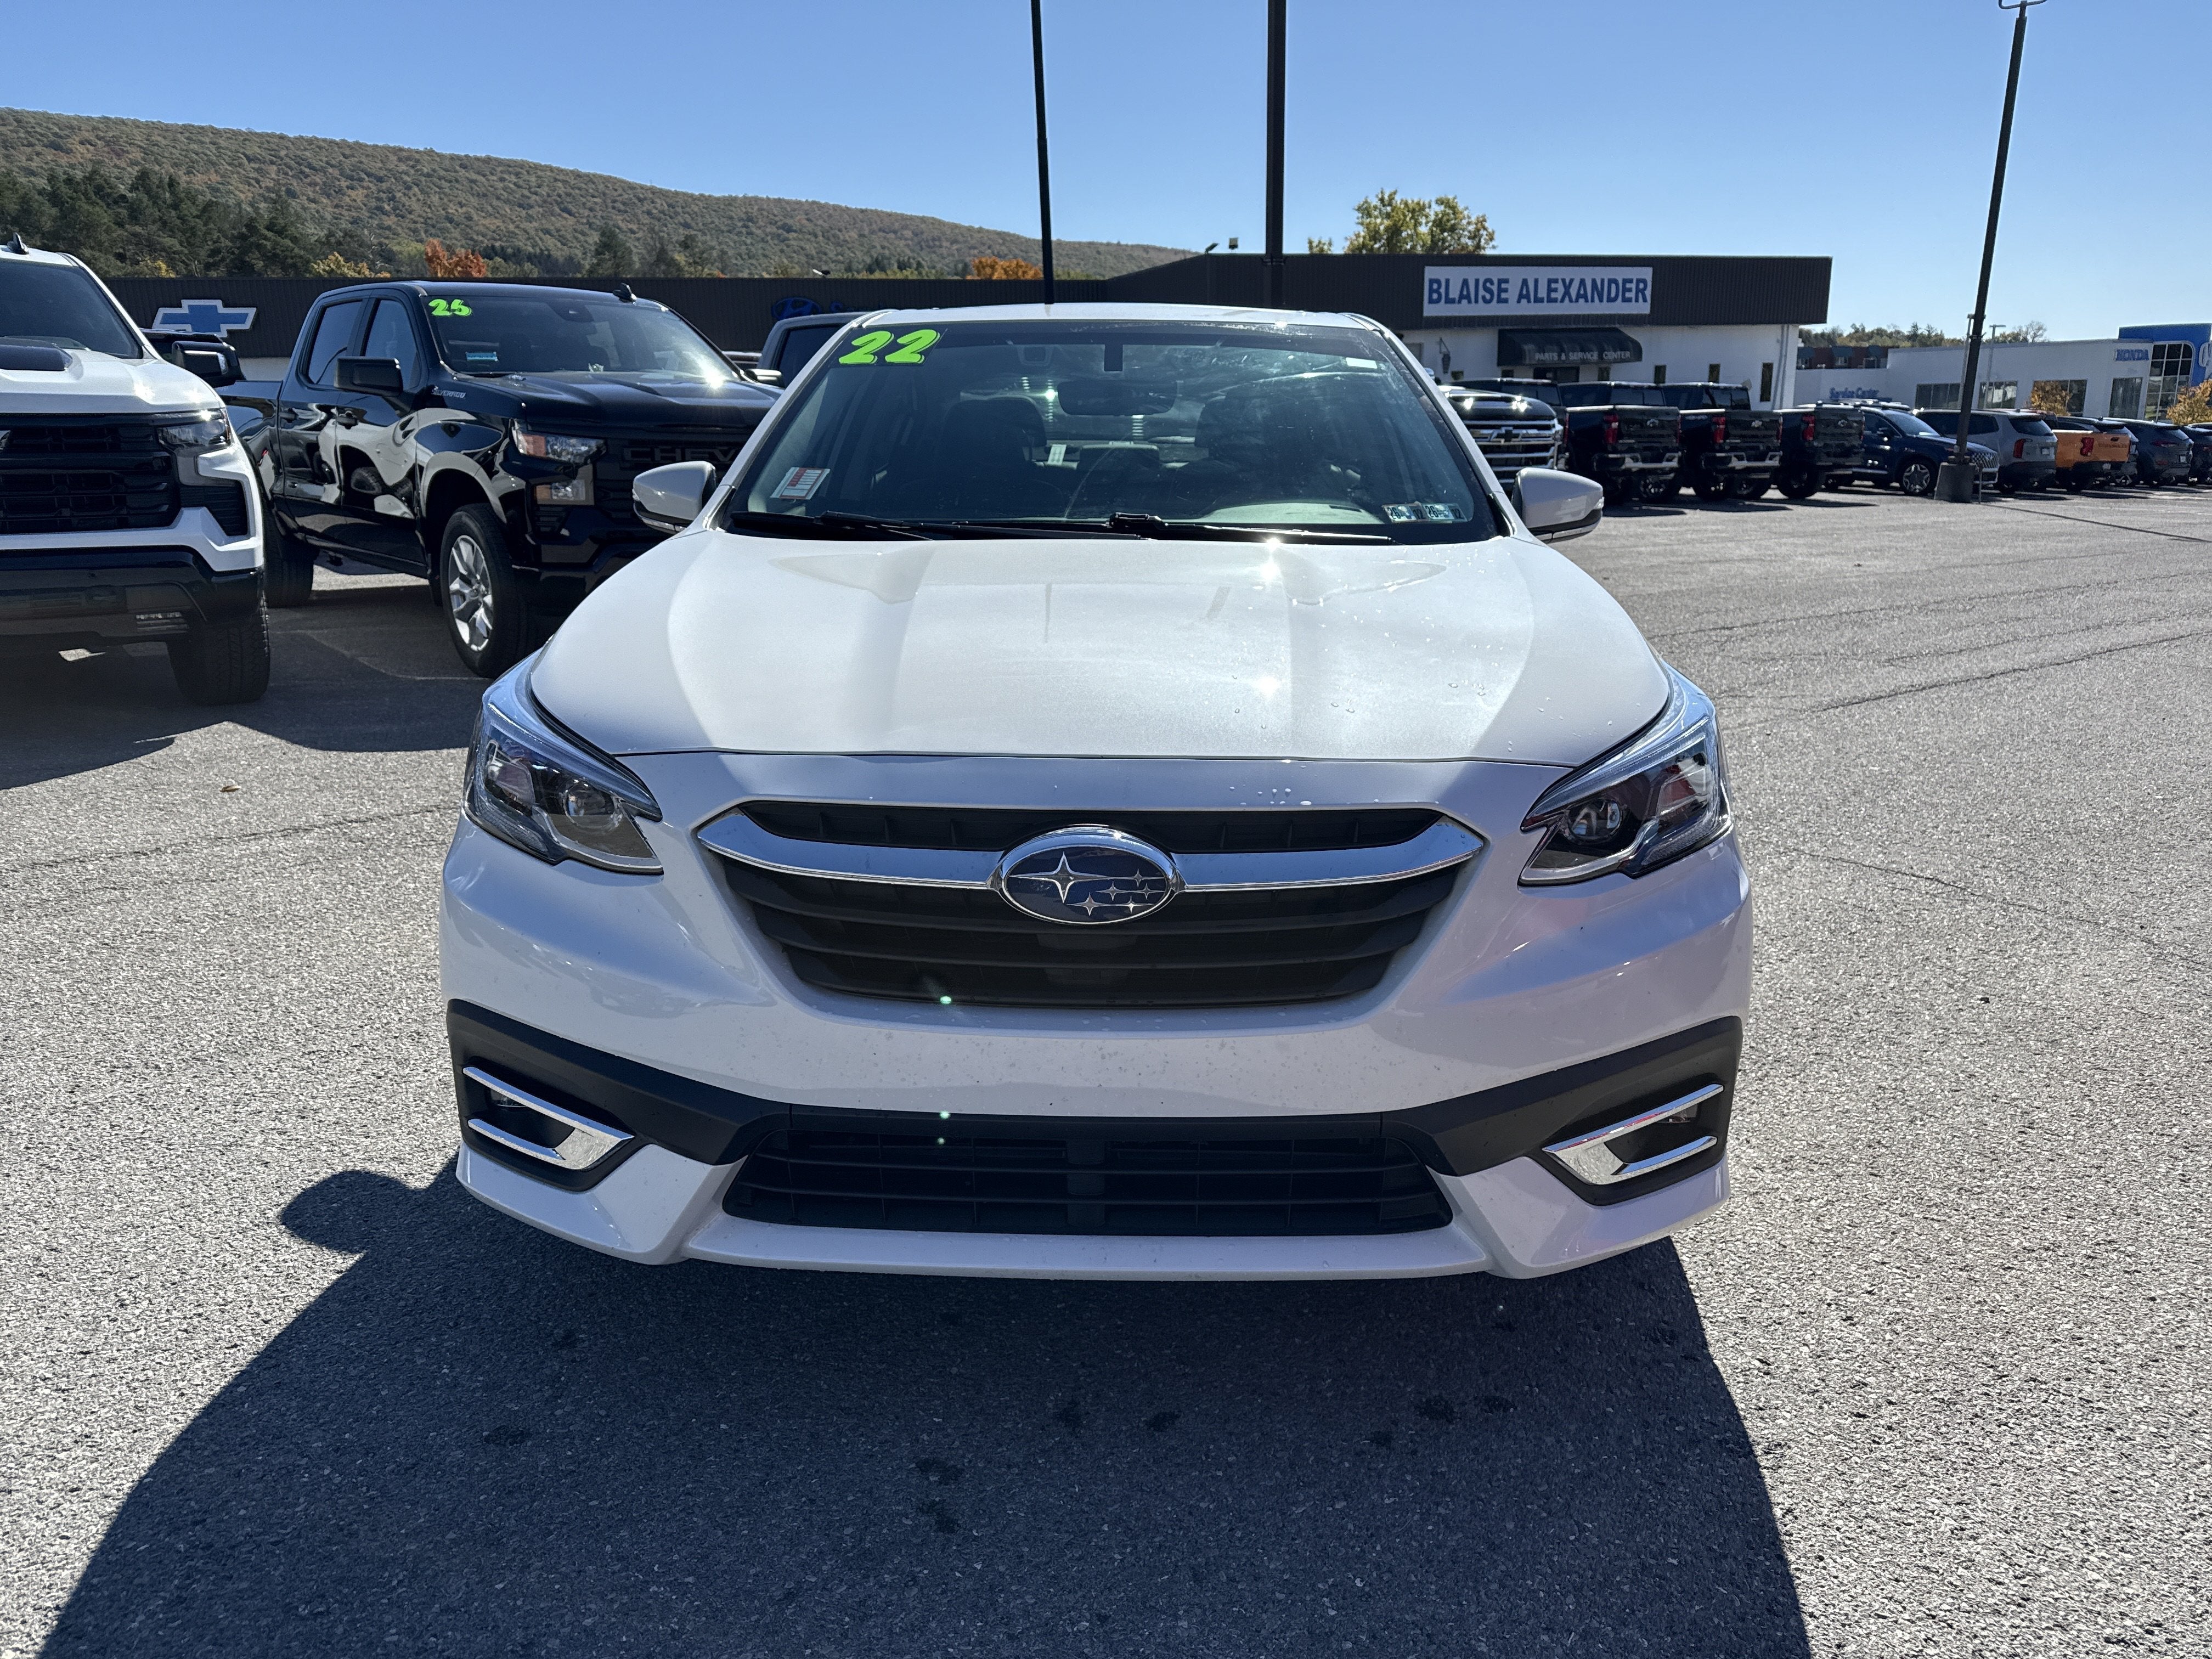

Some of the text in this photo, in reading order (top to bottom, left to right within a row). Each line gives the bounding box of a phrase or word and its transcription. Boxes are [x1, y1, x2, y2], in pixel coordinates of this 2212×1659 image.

[1427, 277, 1648, 304] BLAISE ALEXANDER
[838, 329, 941, 364] 22
[1536, 351, 1631, 360] PARTS & SERVICE CENTER
[2116, 349, 2149, 360] HONDA
[1387, 507, 1401, 520] 26
[1425, 505, 1439, 518] 26
